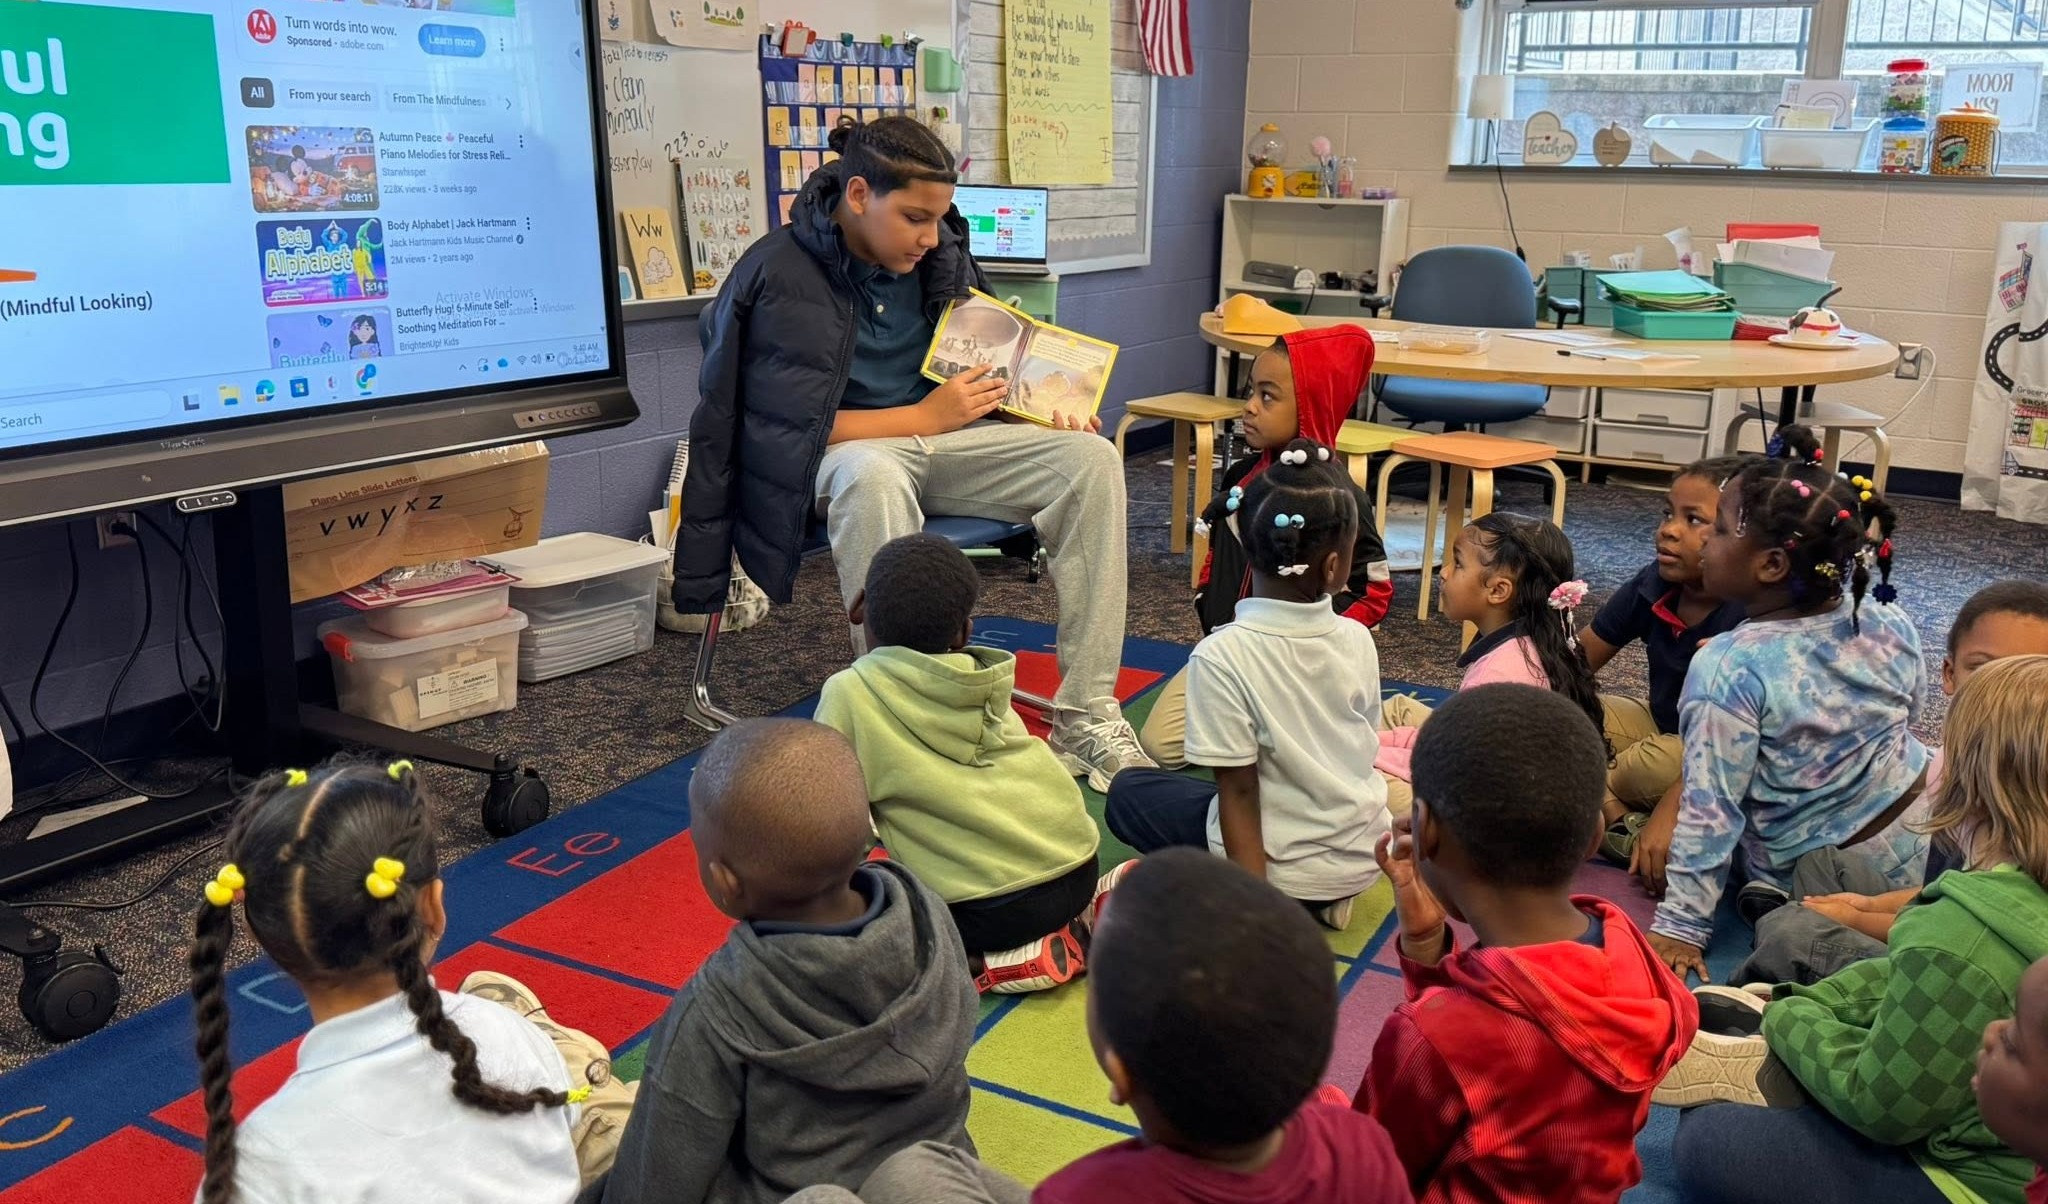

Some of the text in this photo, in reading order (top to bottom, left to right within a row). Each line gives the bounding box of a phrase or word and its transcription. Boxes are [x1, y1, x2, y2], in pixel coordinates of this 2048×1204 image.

[285, 16, 397, 36] Turn words into wow.
[287, 35, 384, 51] Sponsored adobe.com
[428, 34, 477, 47] Learn more
[250, 86, 265, 98] All
[289, 88, 371, 102] From your search
[393, 93, 486, 106] From The Mindfulness
[775, 121, 784, 135] g
[804, 118, 812, 131] h
[379, 132, 494, 144] Autumn Peace Peaceful
[381, 149, 406, 159] Piano
[408, 149, 447, 160] Melodies
[448, 149, 460, 160] for
[462, 150, 488, 161] Stress
[786, 163, 795, 175] n
[406, 185, 427, 194] views
[433, 184, 439, 194] 3
[441, 184, 463, 193] weeks
[464, 185, 477, 195] ago
[343, 192, 374, 203] 4:08:11
[388, 217, 517, 232] Body Alphabet Jack Hartmann
[630, 213, 663, 238] Ww
[278, 228, 311, 248] Body
[389, 234, 514, 248] Jack Hartmann Kids Music Channel
[267, 247, 353, 281] Alphabet
[391, 253, 474, 265] 2M views 2 years ago
[365, 282, 384, 292] 5:14
[436, 287, 535, 304] Activate Windows
[1, 290, 153, 322] (Mindful Looking)
[396, 305, 433, 318] Butterfly
[435, 304, 455, 316] Hug!
[456, 301, 493, 313] 6-Minute
[494, 299, 513, 310] Self-
[398, 320, 436, 334] Soothing
[438, 317, 482, 331] Meditation
[484, 316, 497, 327] For
[400, 338, 460, 351] BrightenUp! Kids
[0, 413, 42, 429] Search
[310, 474, 418, 507] Plane Line Slide Letters
[319, 494, 444, 537] v w y x z
[506, 832, 621, 877] Ee
